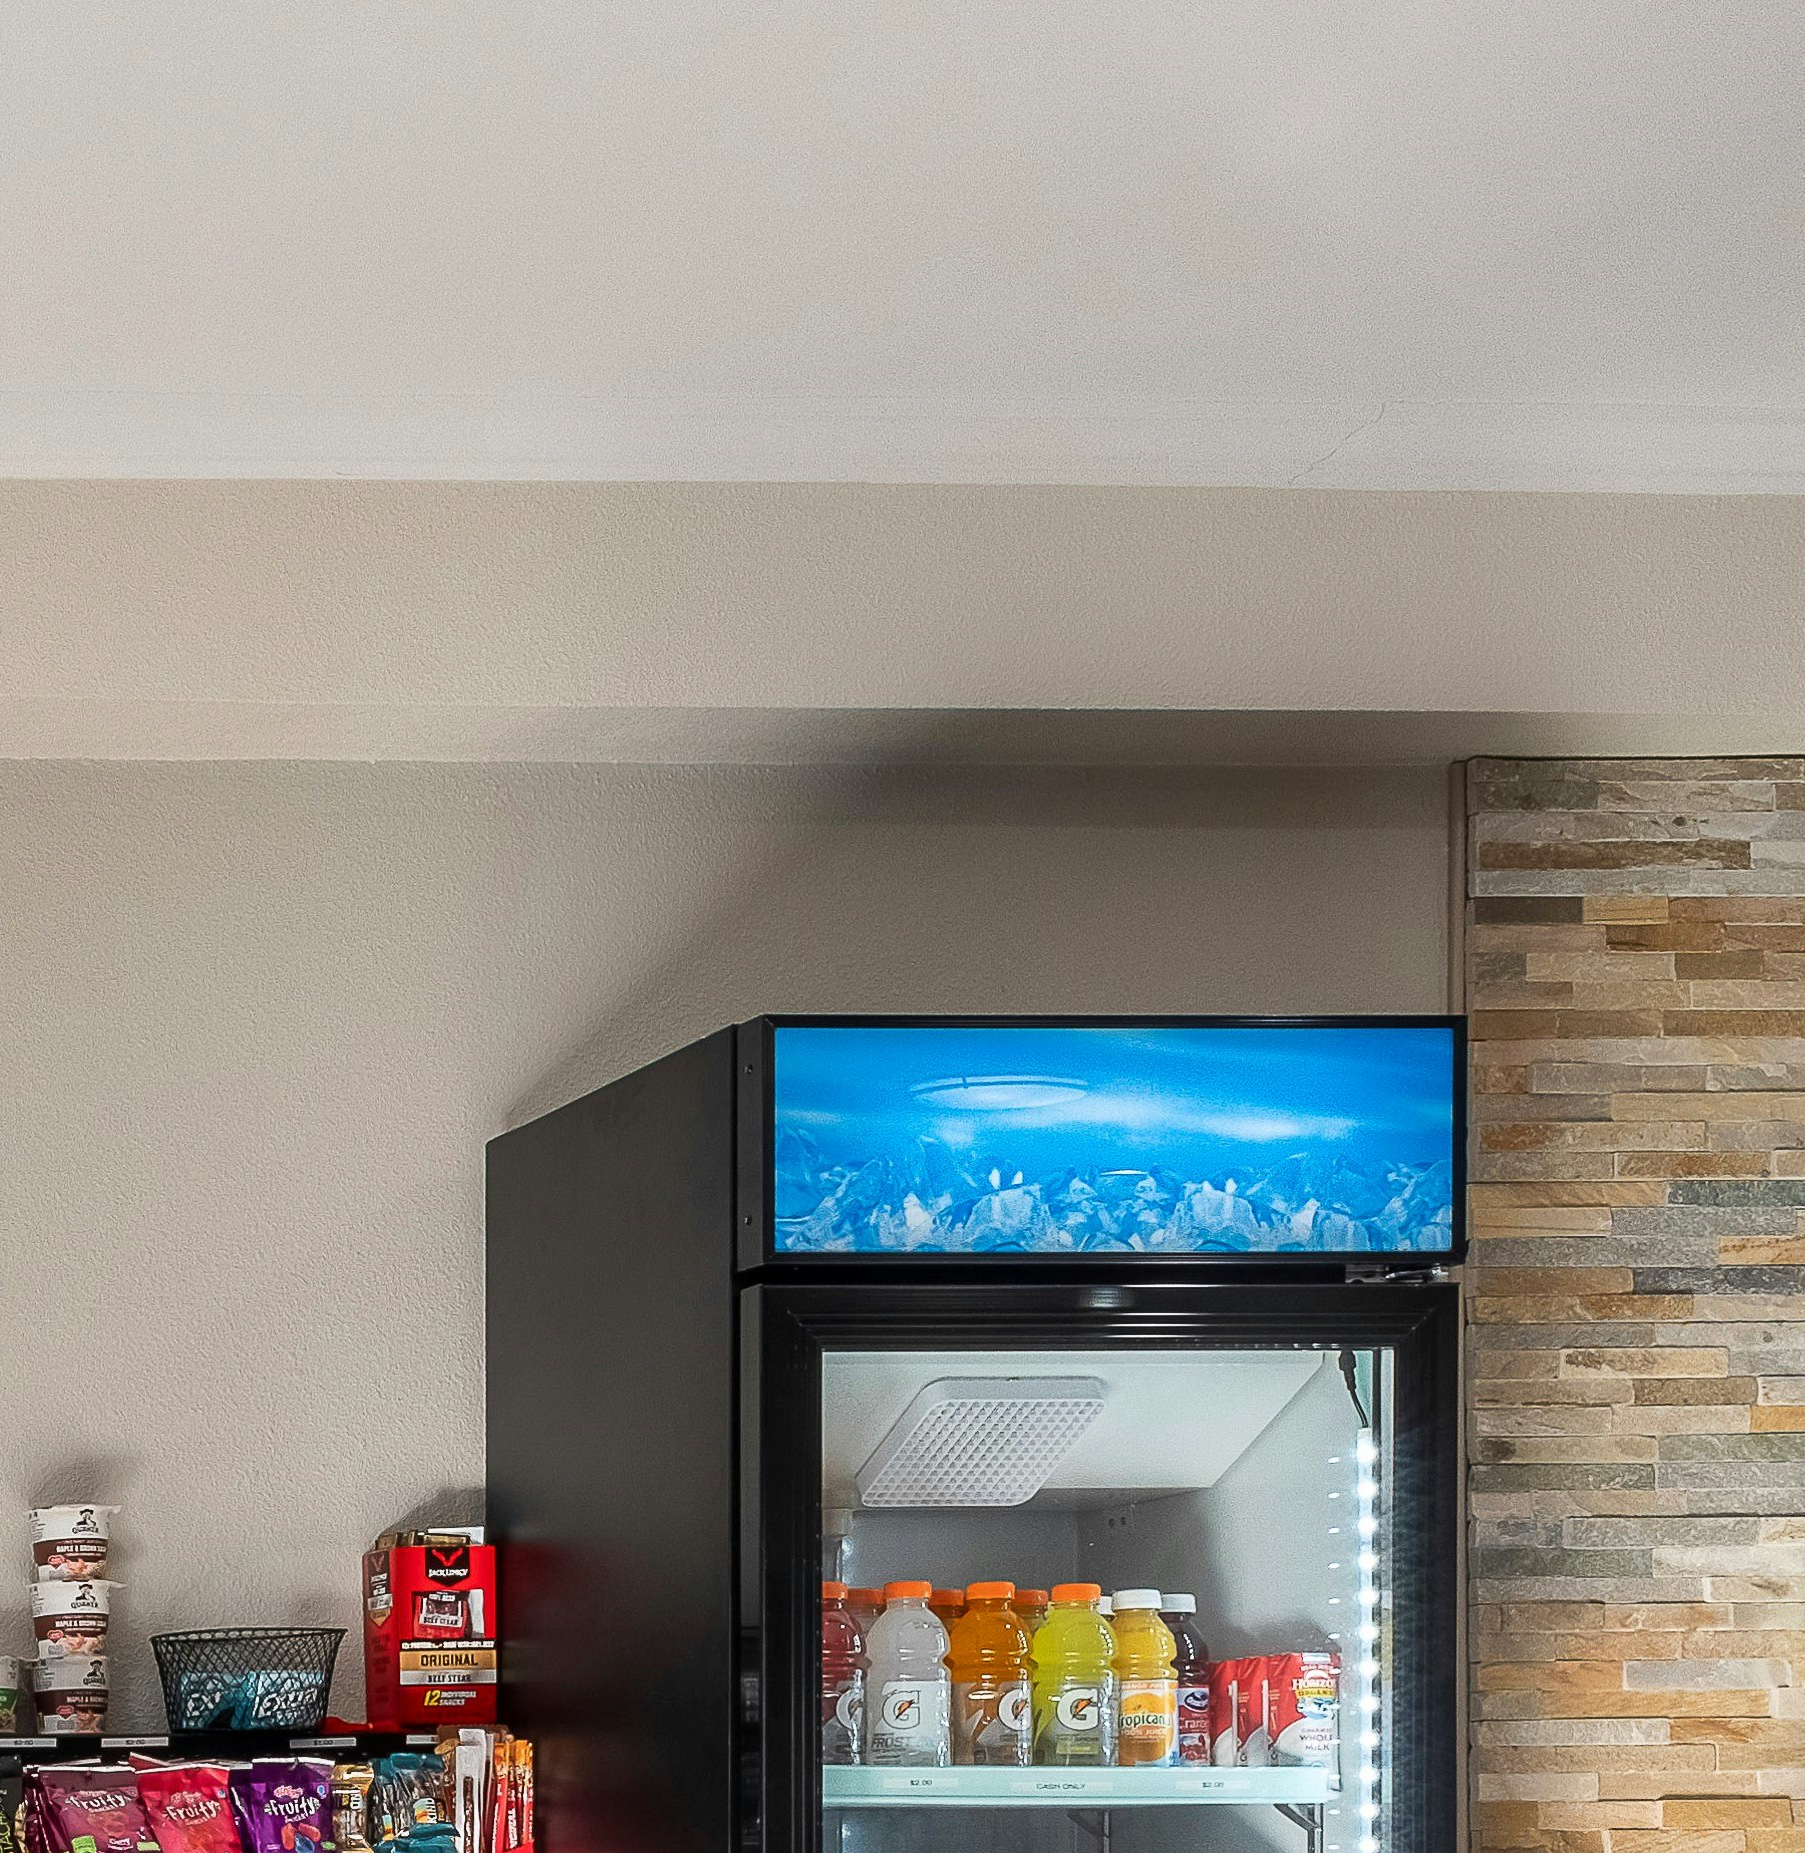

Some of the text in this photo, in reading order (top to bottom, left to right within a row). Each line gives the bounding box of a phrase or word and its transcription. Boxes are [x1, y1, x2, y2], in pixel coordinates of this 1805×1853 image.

[421, 1655, 478, 1666] ORIGINAL
[428, 1675, 445, 1683] BEEF
[881, 1689, 921, 1732] G
[1300, 1734, 1333, 1742] WHOLE
[1305, 1743, 1330, 1752] MILK
